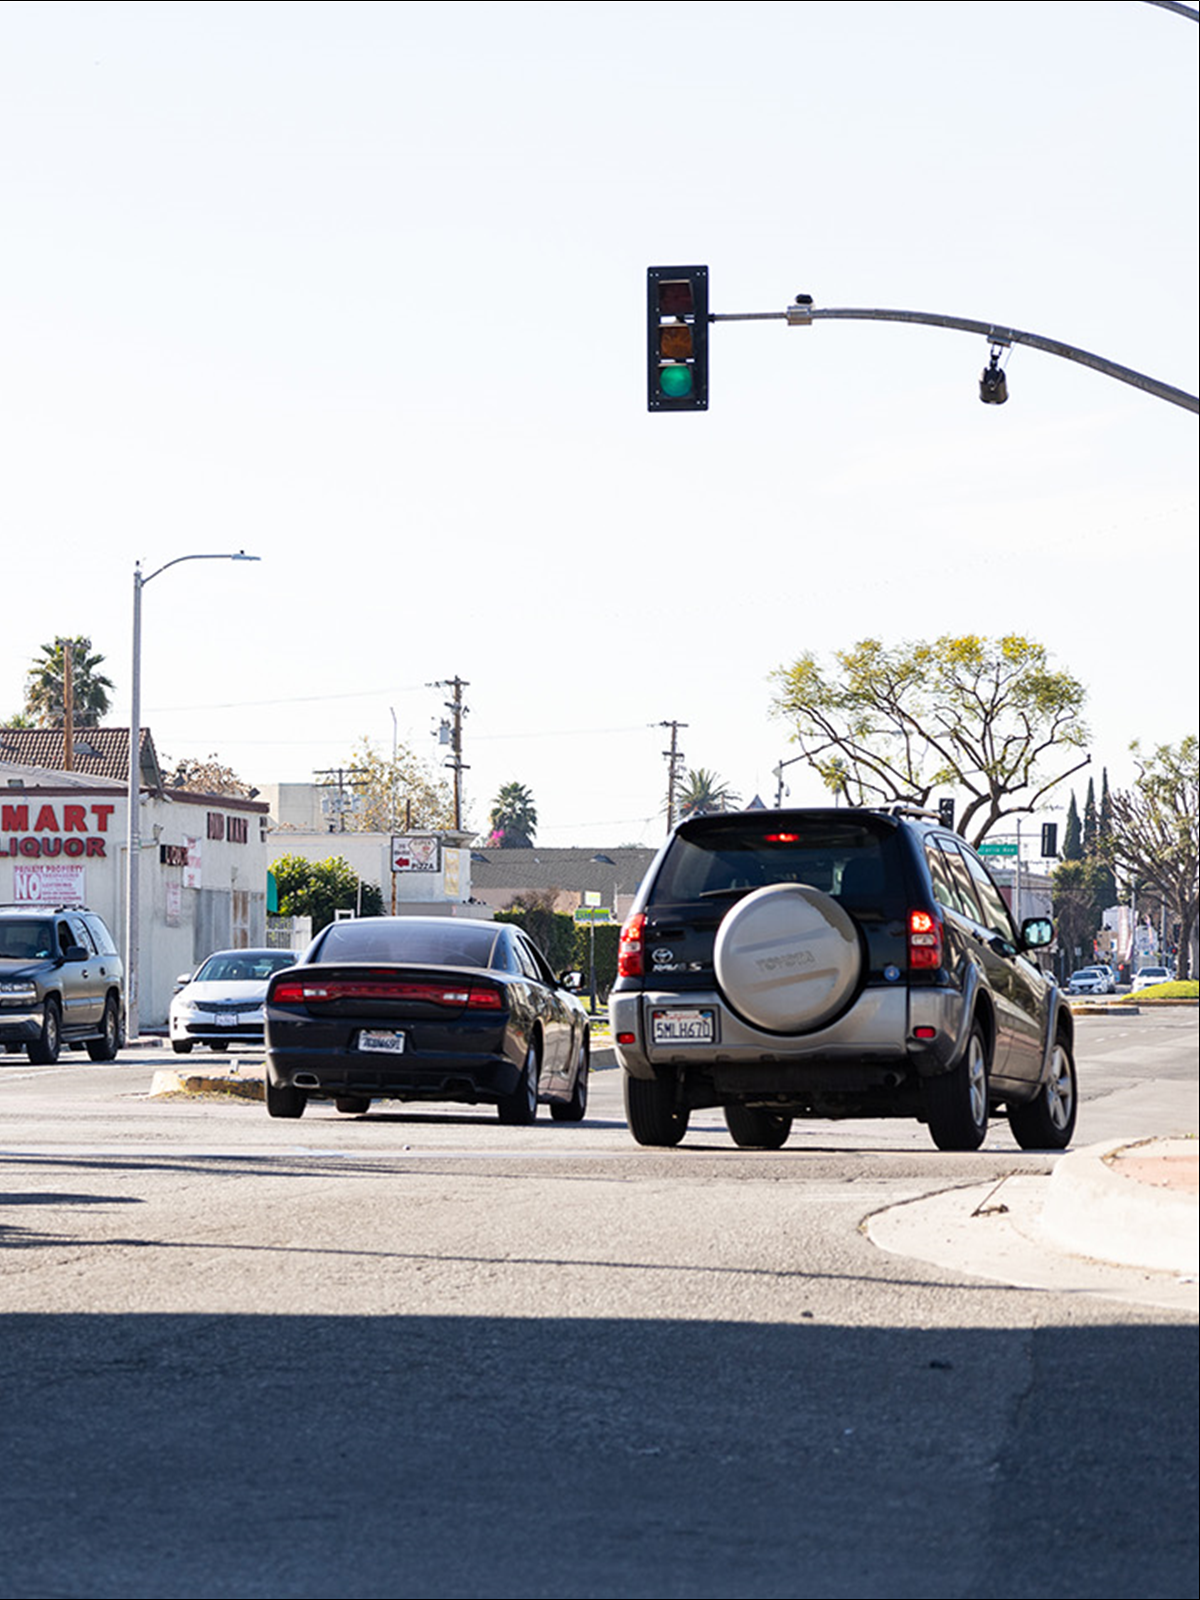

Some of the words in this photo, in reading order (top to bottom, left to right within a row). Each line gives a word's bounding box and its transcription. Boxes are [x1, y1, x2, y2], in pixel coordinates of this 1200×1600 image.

[1, 804, 115, 832] MART
[45, 864, 83, 873] PROPERTY
[411, 862, 434, 870] PIZZA
[15, 873, 42, 900] NO
